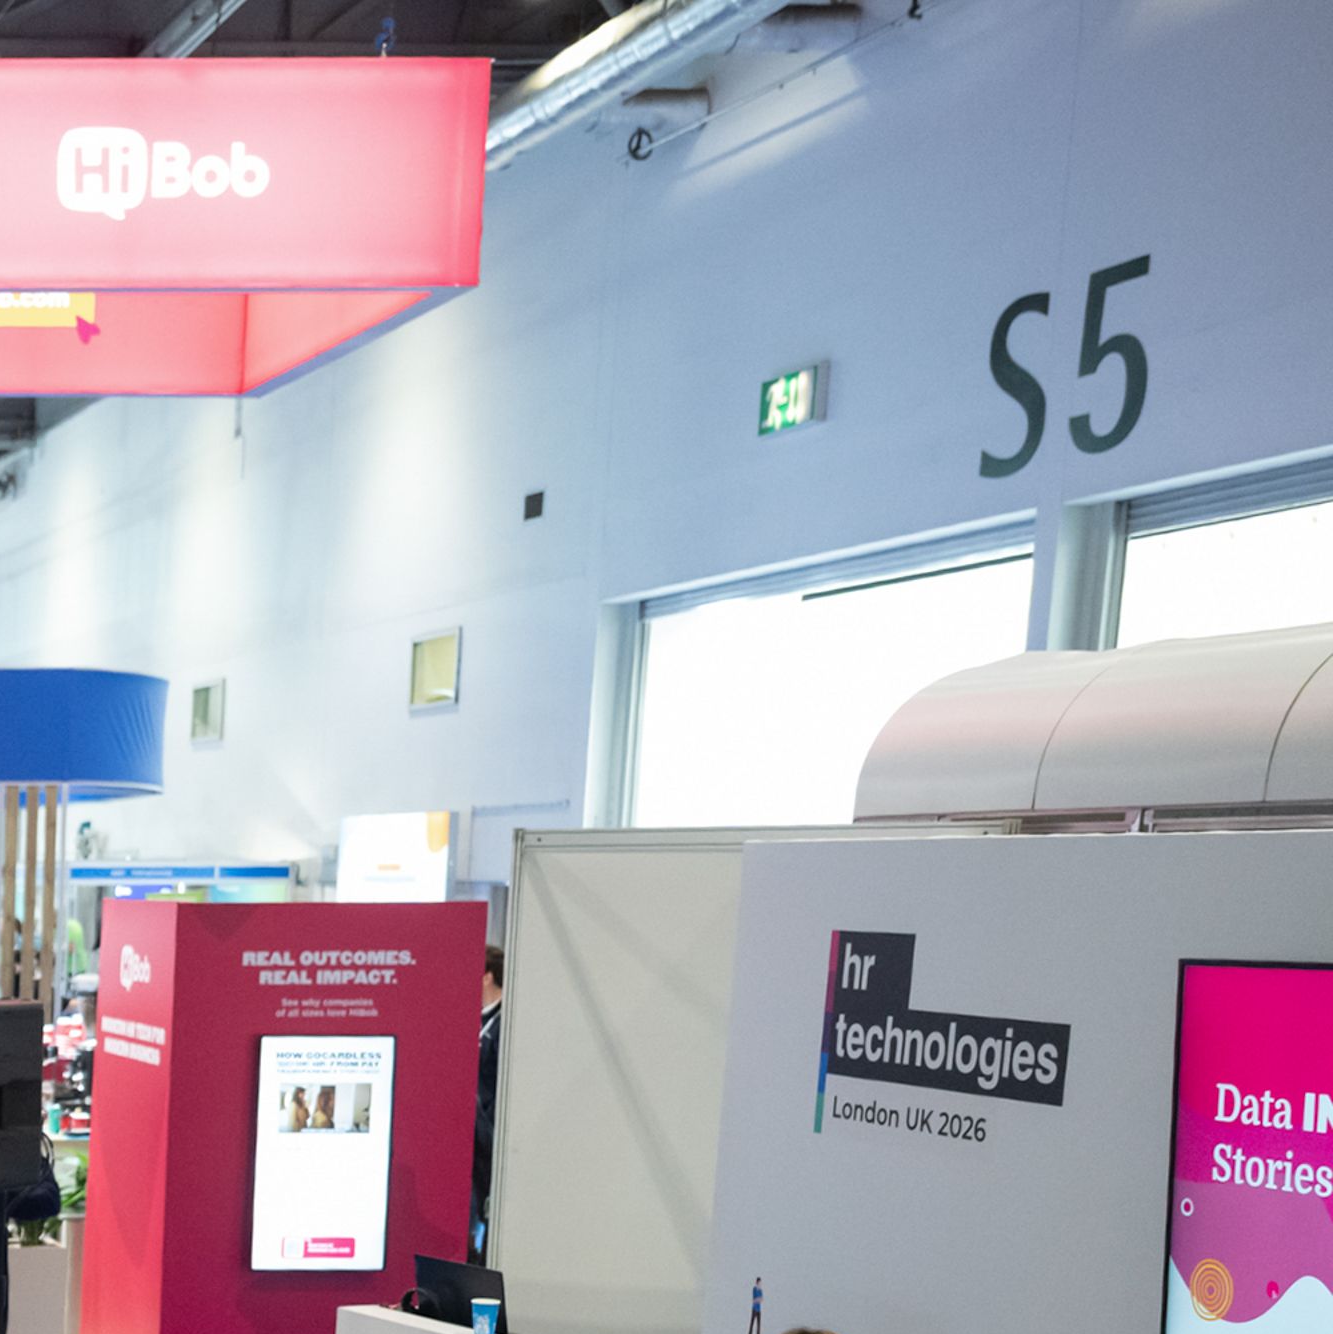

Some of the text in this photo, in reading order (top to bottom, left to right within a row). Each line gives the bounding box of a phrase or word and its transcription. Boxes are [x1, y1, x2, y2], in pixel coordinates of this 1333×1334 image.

[65, 133, 270, 209] HiBob
[978, 253, 1152, 479] S5
[242, 950, 417, 967] REAL OUTCOMES.
[259, 969, 398, 985] REAL IMPACT.
[841, 942, 877, 991] hr
[835, 1013, 1059, 1091] technologies
[832, 1095, 987, 1142] London UK 2026
[1214, 1082, 1294, 1131] Data
[1211, 1142, 1333, 1198] Stories
